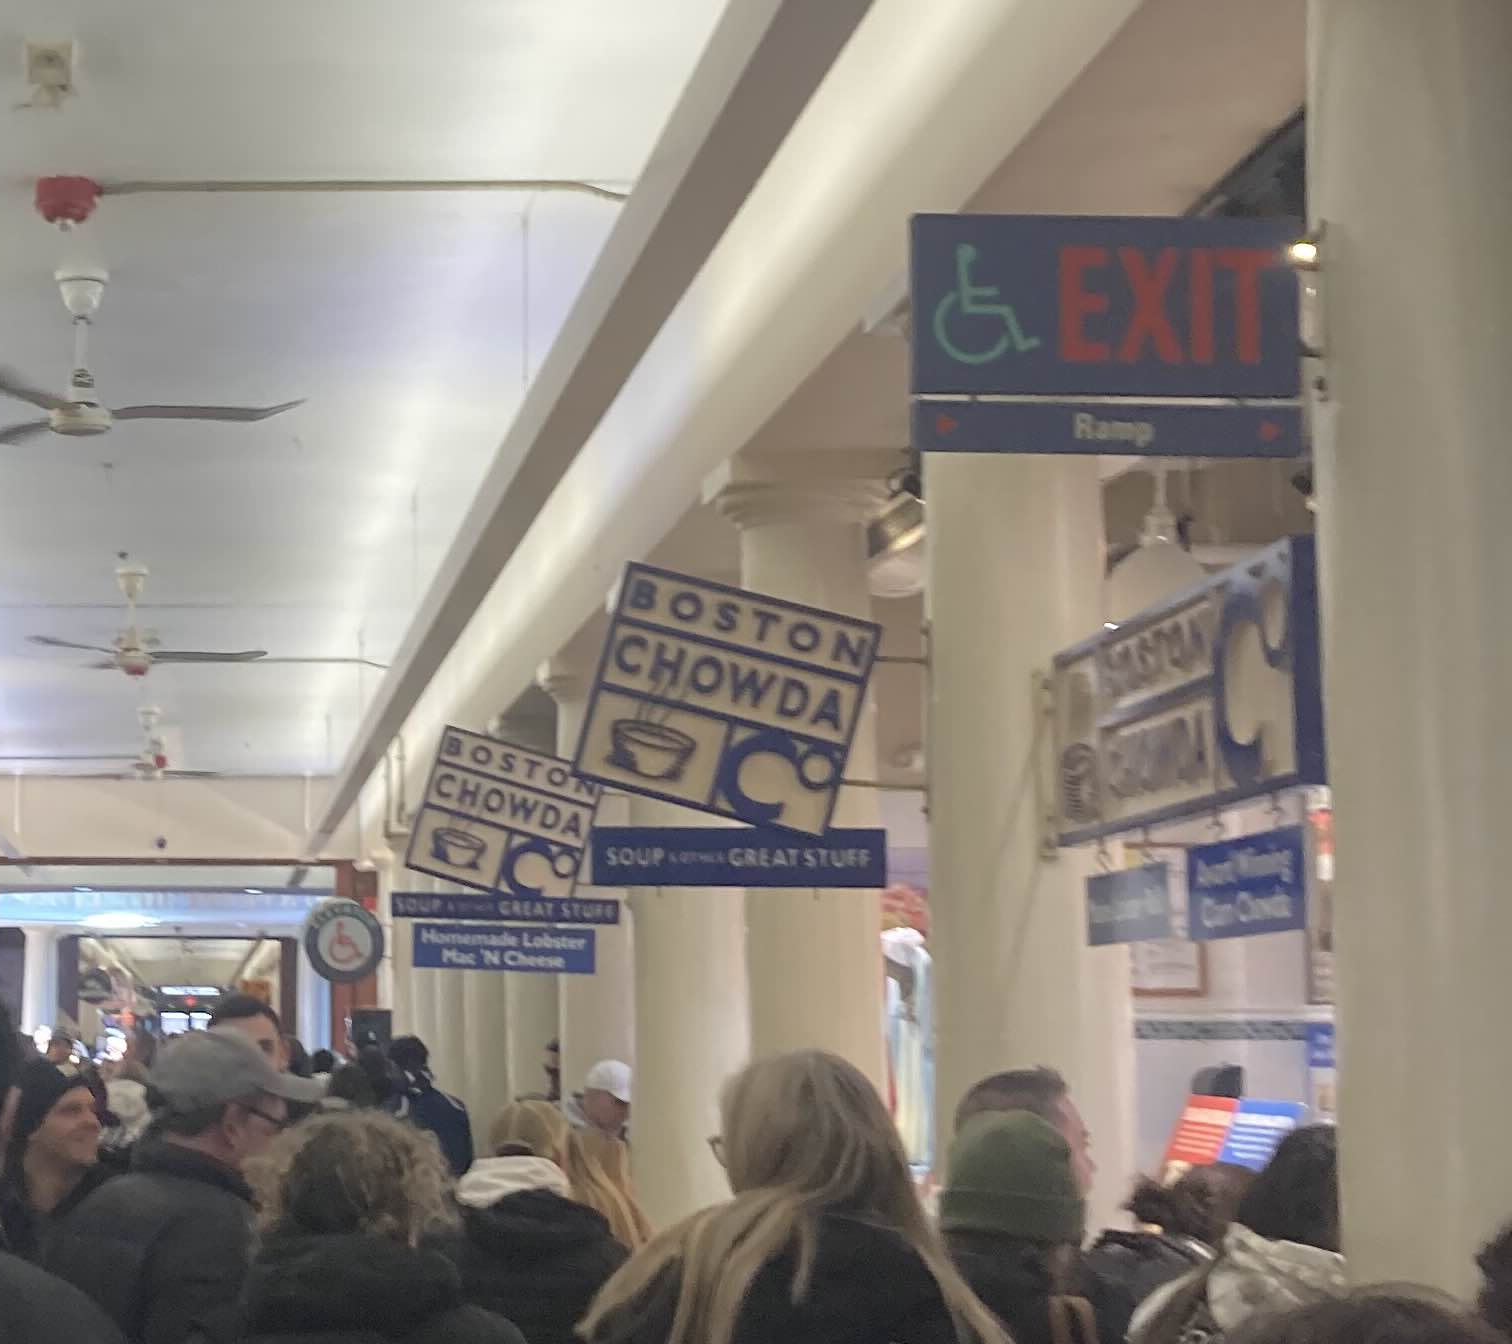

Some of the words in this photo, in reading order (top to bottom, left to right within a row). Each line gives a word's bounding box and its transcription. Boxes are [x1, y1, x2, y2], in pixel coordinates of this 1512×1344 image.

[1058, 245, 1274, 365] EXIT
[1073, 413, 1155, 447] Ramp
[630, 578, 870, 668] BOSTON
[613, 635, 842, 730] CHOWDA
[445, 736, 600, 794] BOSTON
[435, 773, 580, 838] CHOWDA
[606, 847, 664, 866] SOUP
[727, 847, 798, 867] GREAT
[803, 849, 872, 869] STUFF
[498, 901, 553, 917] GREAT
[420, 927, 519, 948] Homemade
[522, 932, 587, 951] Lobster
[441, 948, 477, 966] Mac
[503, 951, 567, 970] Cheese
